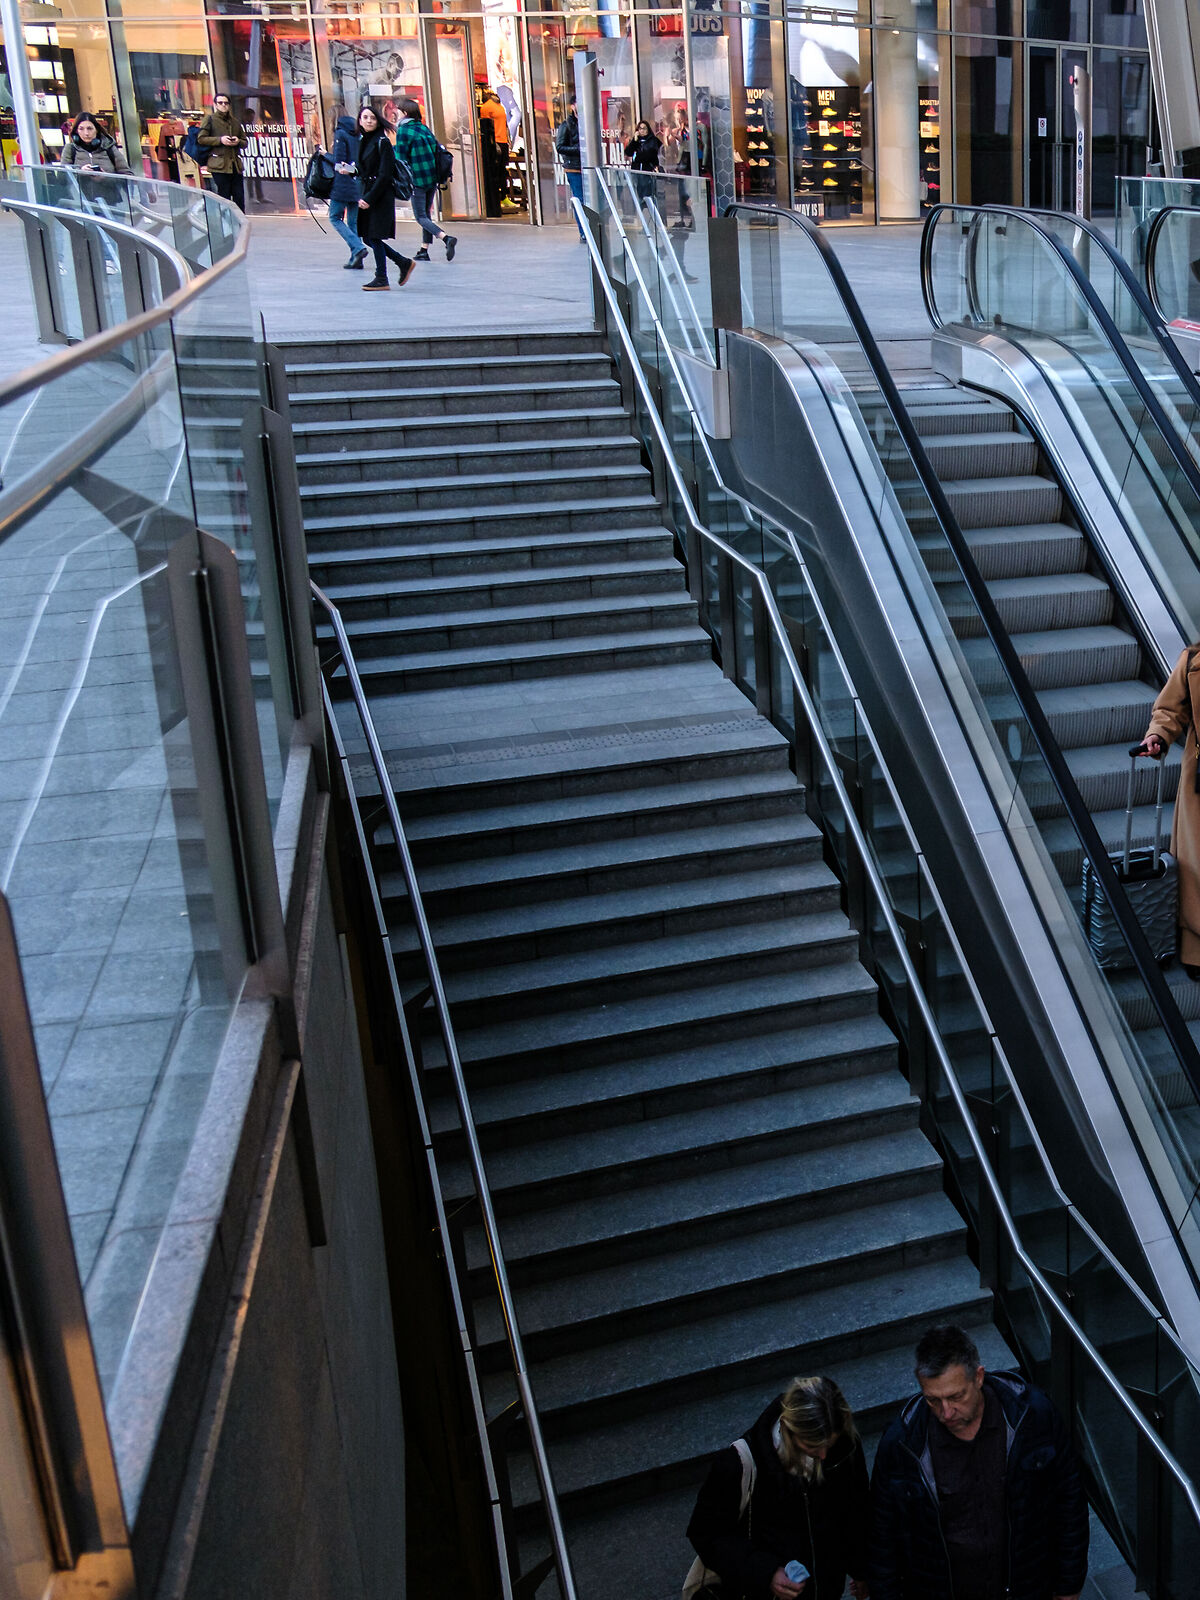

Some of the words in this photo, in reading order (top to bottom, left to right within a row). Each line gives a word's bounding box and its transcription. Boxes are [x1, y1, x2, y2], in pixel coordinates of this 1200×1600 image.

[746, 88, 765, 99] WOM
[817, 90, 835, 100] MEN
[240, 136, 258, 157] OU
[259, 136, 281, 157] GIVE
[281, 136, 292, 158] IT
[256, 157, 280, 178] GIVE
[279, 157, 289, 178] IT
[290, 157, 310, 179] BAC
[811, 203, 818, 217] IS
